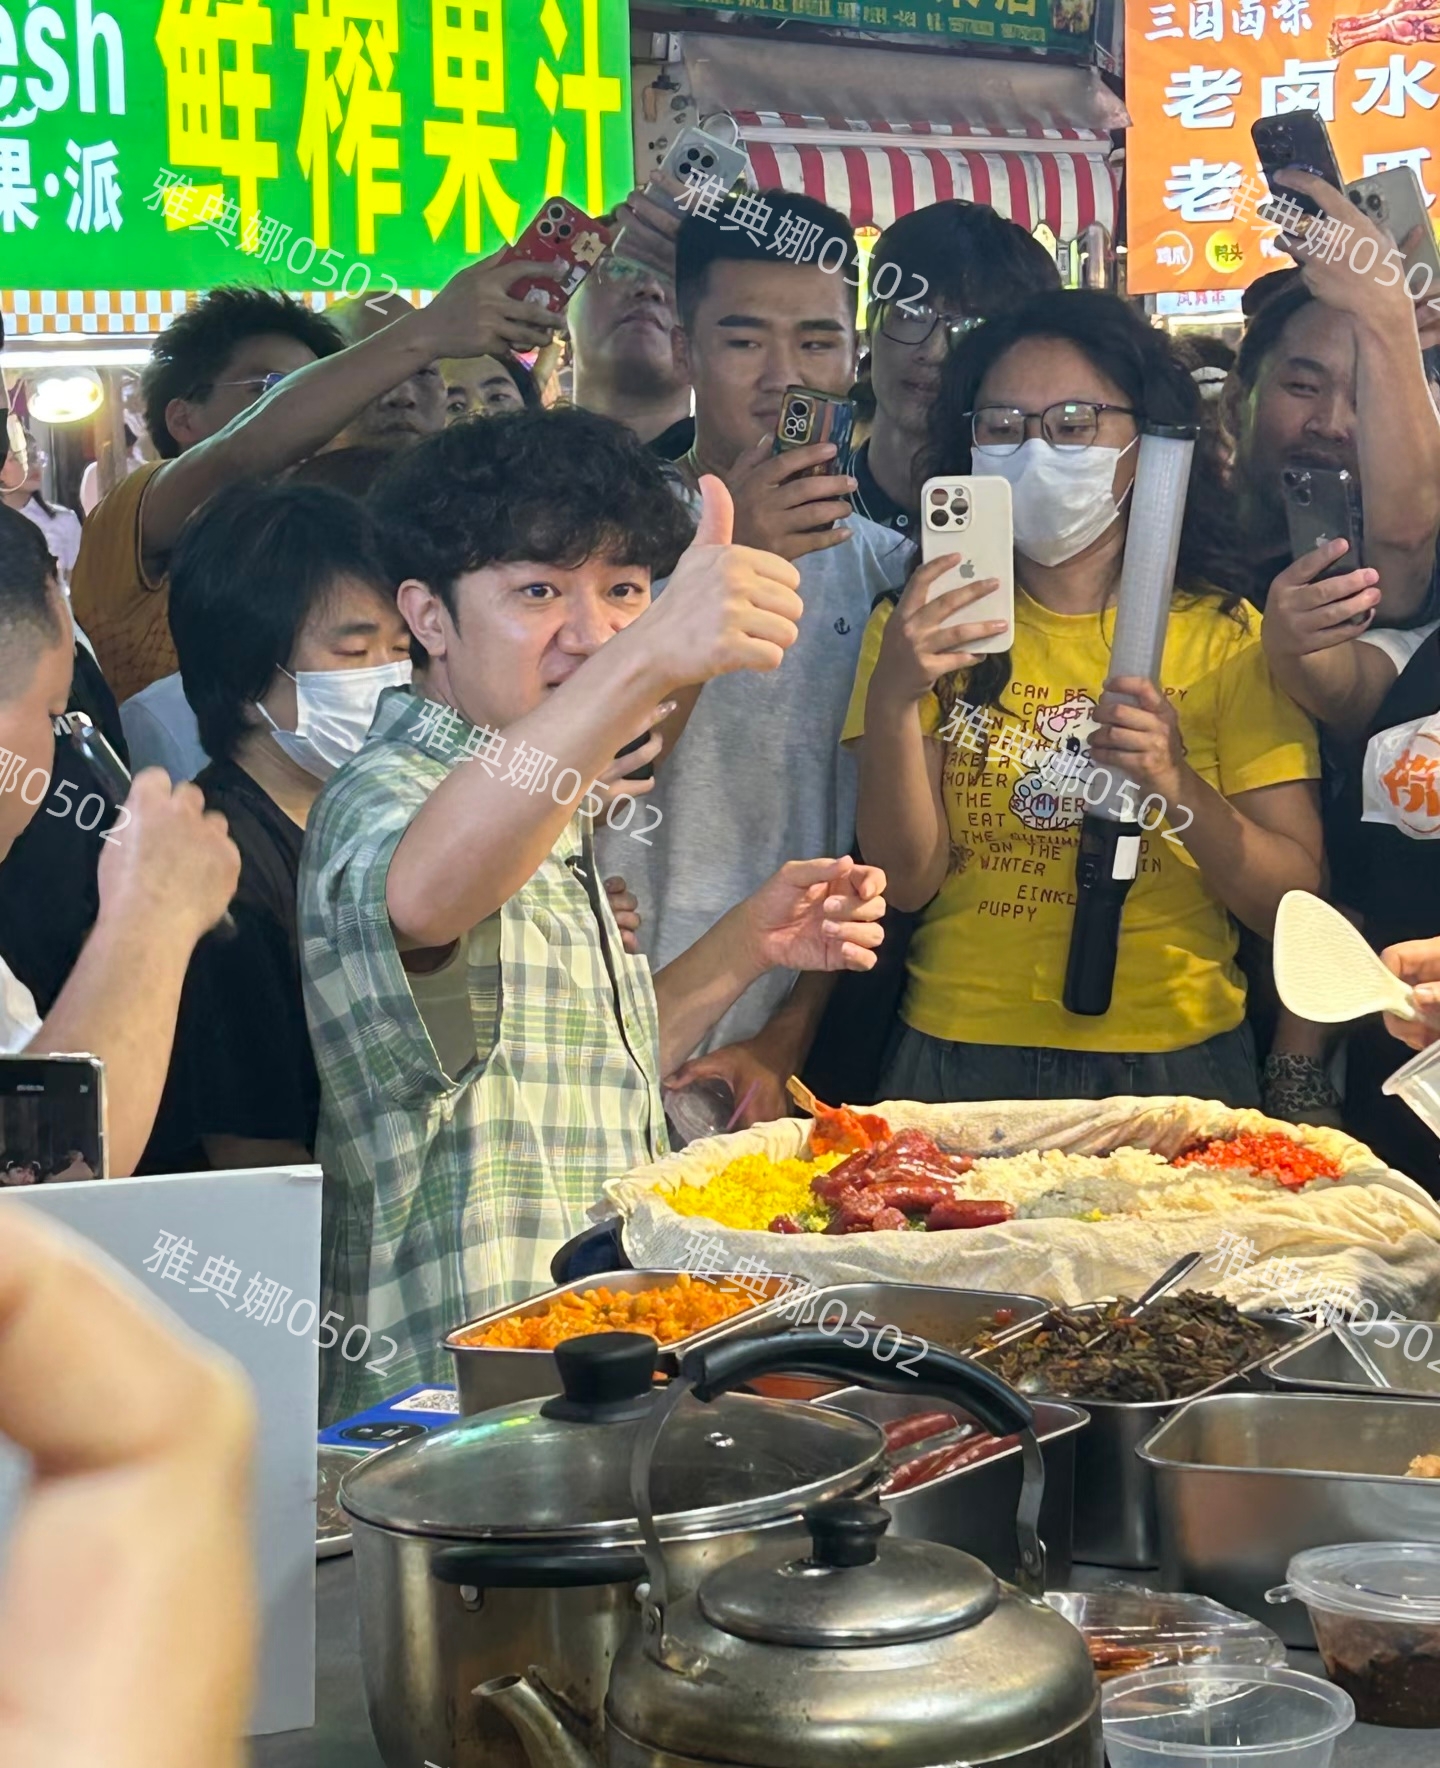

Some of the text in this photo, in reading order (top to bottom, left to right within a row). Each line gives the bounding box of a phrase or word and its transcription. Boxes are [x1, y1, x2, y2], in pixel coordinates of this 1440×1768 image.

[1162, 54, 1440, 129] 老卤水
[155, 0, 621, 254] 鲜榨果汁
[1011, 682, 1049, 699] CAN
[1065, 688, 1088, 702] BE
[956, 792, 992, 808] THE
[968, 812, 1006, 827] EAT
[961, 830, 994, 845] THE
[989, 842, 1061, 861] ON THE
[980, 856, 1046, 876] WINTER
[978, 900, 1037, 922] PUPPY
